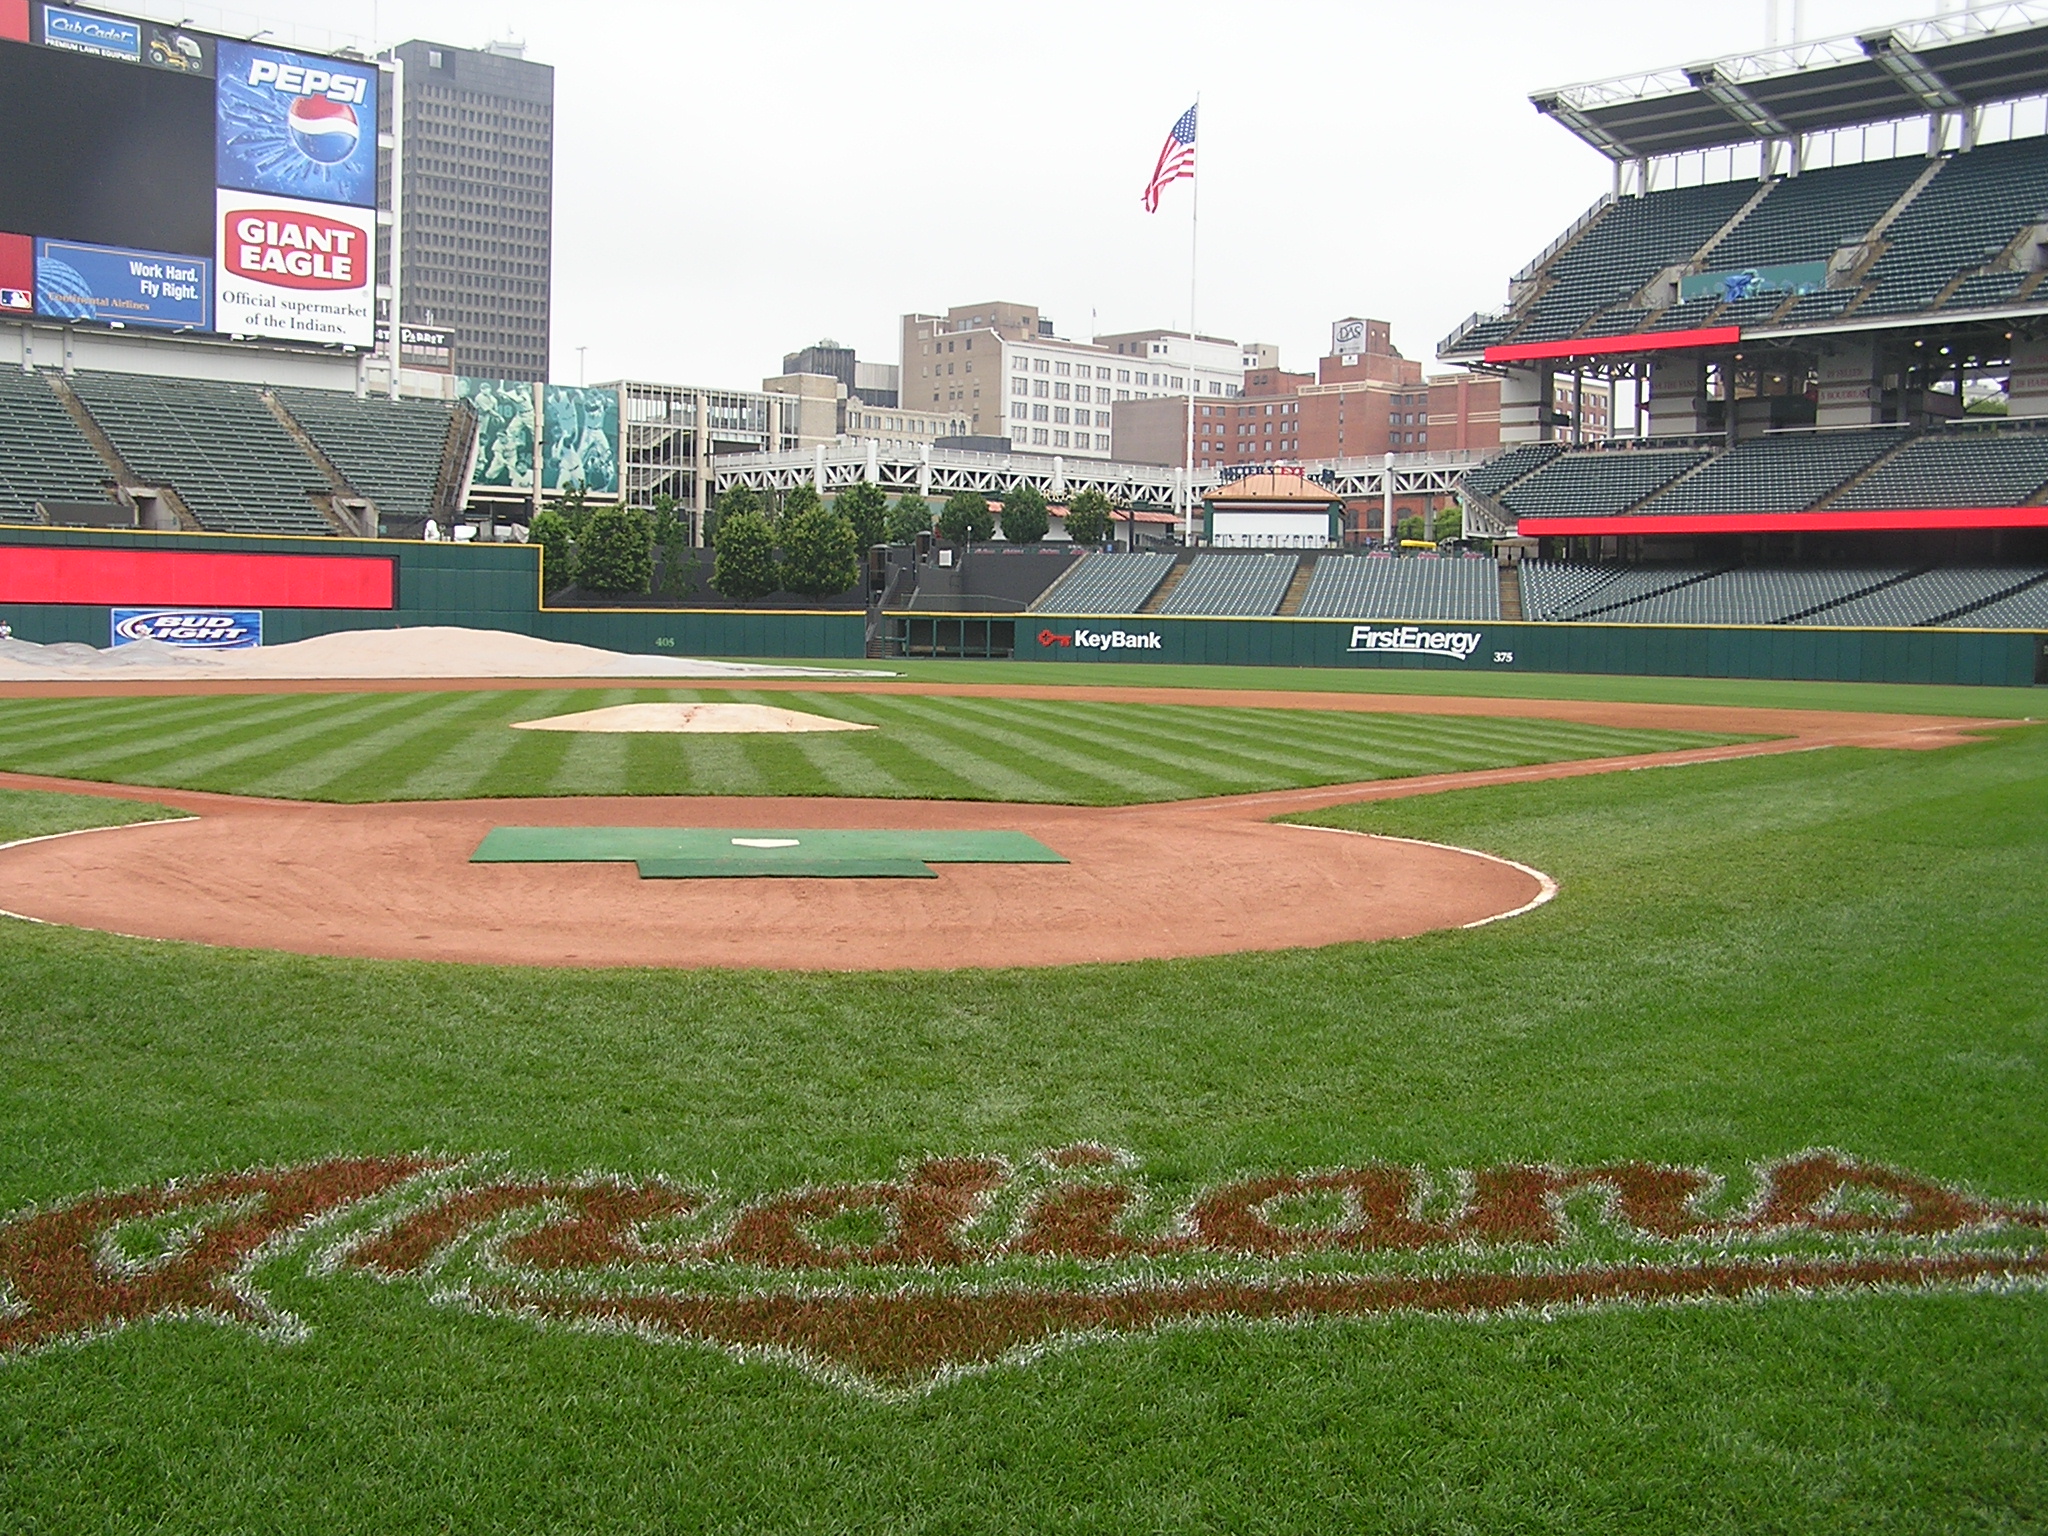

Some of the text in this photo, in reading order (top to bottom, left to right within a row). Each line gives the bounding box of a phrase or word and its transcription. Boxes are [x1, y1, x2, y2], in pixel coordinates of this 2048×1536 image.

[52, 18, 134, 43] Cub Cadet
[45, 38, 141, 63] PREMIUM LAWN EQUIPMENT
[248, 58, 367, 104] PEPSI
[237, 218, 355, 254] GIANT
[130, 261, 199, 282] Work Hard.
[240, 244, 352, 281] EAGLE
[49, 291, 150, 311] Continental Airlines
[140, 280, 199, 301] Fly Right.
[222, 290, 367, 317] Official supermarket
[245, 313, 346, 334] of the Indians.
[154, 616, 235, 628] BUD
[147, 627, 248, 639] LIGHT
[655, 636, 675, 648] 405
[1075, 629, 1161, 651] KeyBank
[1350, 626, 1482, 654] FirstEnergy
[1493, 652, 1514, 663] 375
